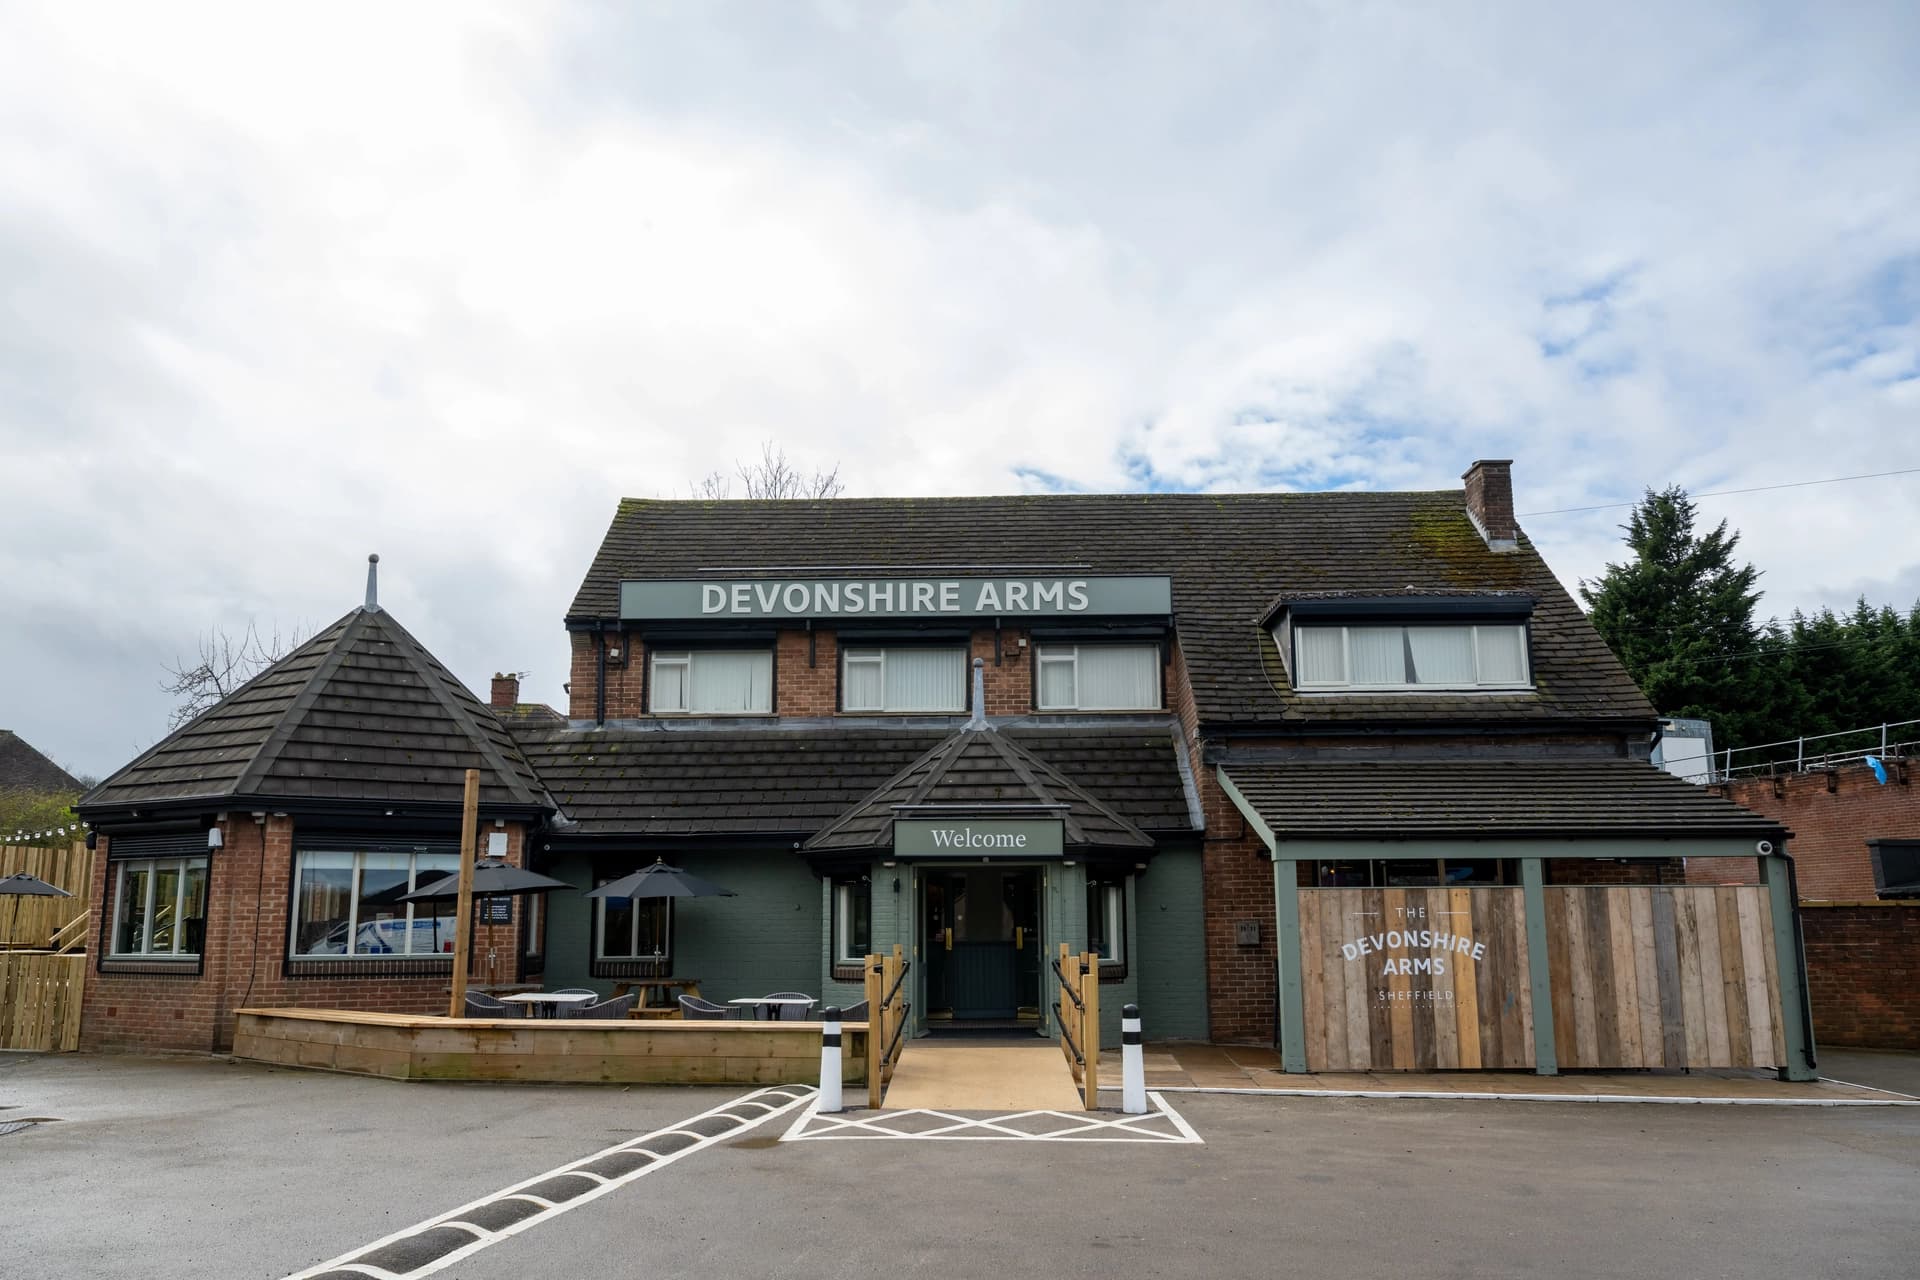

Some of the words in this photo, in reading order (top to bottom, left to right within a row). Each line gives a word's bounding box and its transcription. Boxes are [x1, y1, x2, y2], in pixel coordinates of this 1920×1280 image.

[701, 582, 960, 614] DEVONSHIRE
[975, 581, 1090, 612] ARMS
[930, 827, 1027, 848] Welcome
[1395, 907, 1425, 918] THE
[1341, 930, 1486, 961] DEVONSHIRE
[1383, 957, 1445, 976] ARMS
[1378, 990, 1454, 1001] SHEFFIELD
